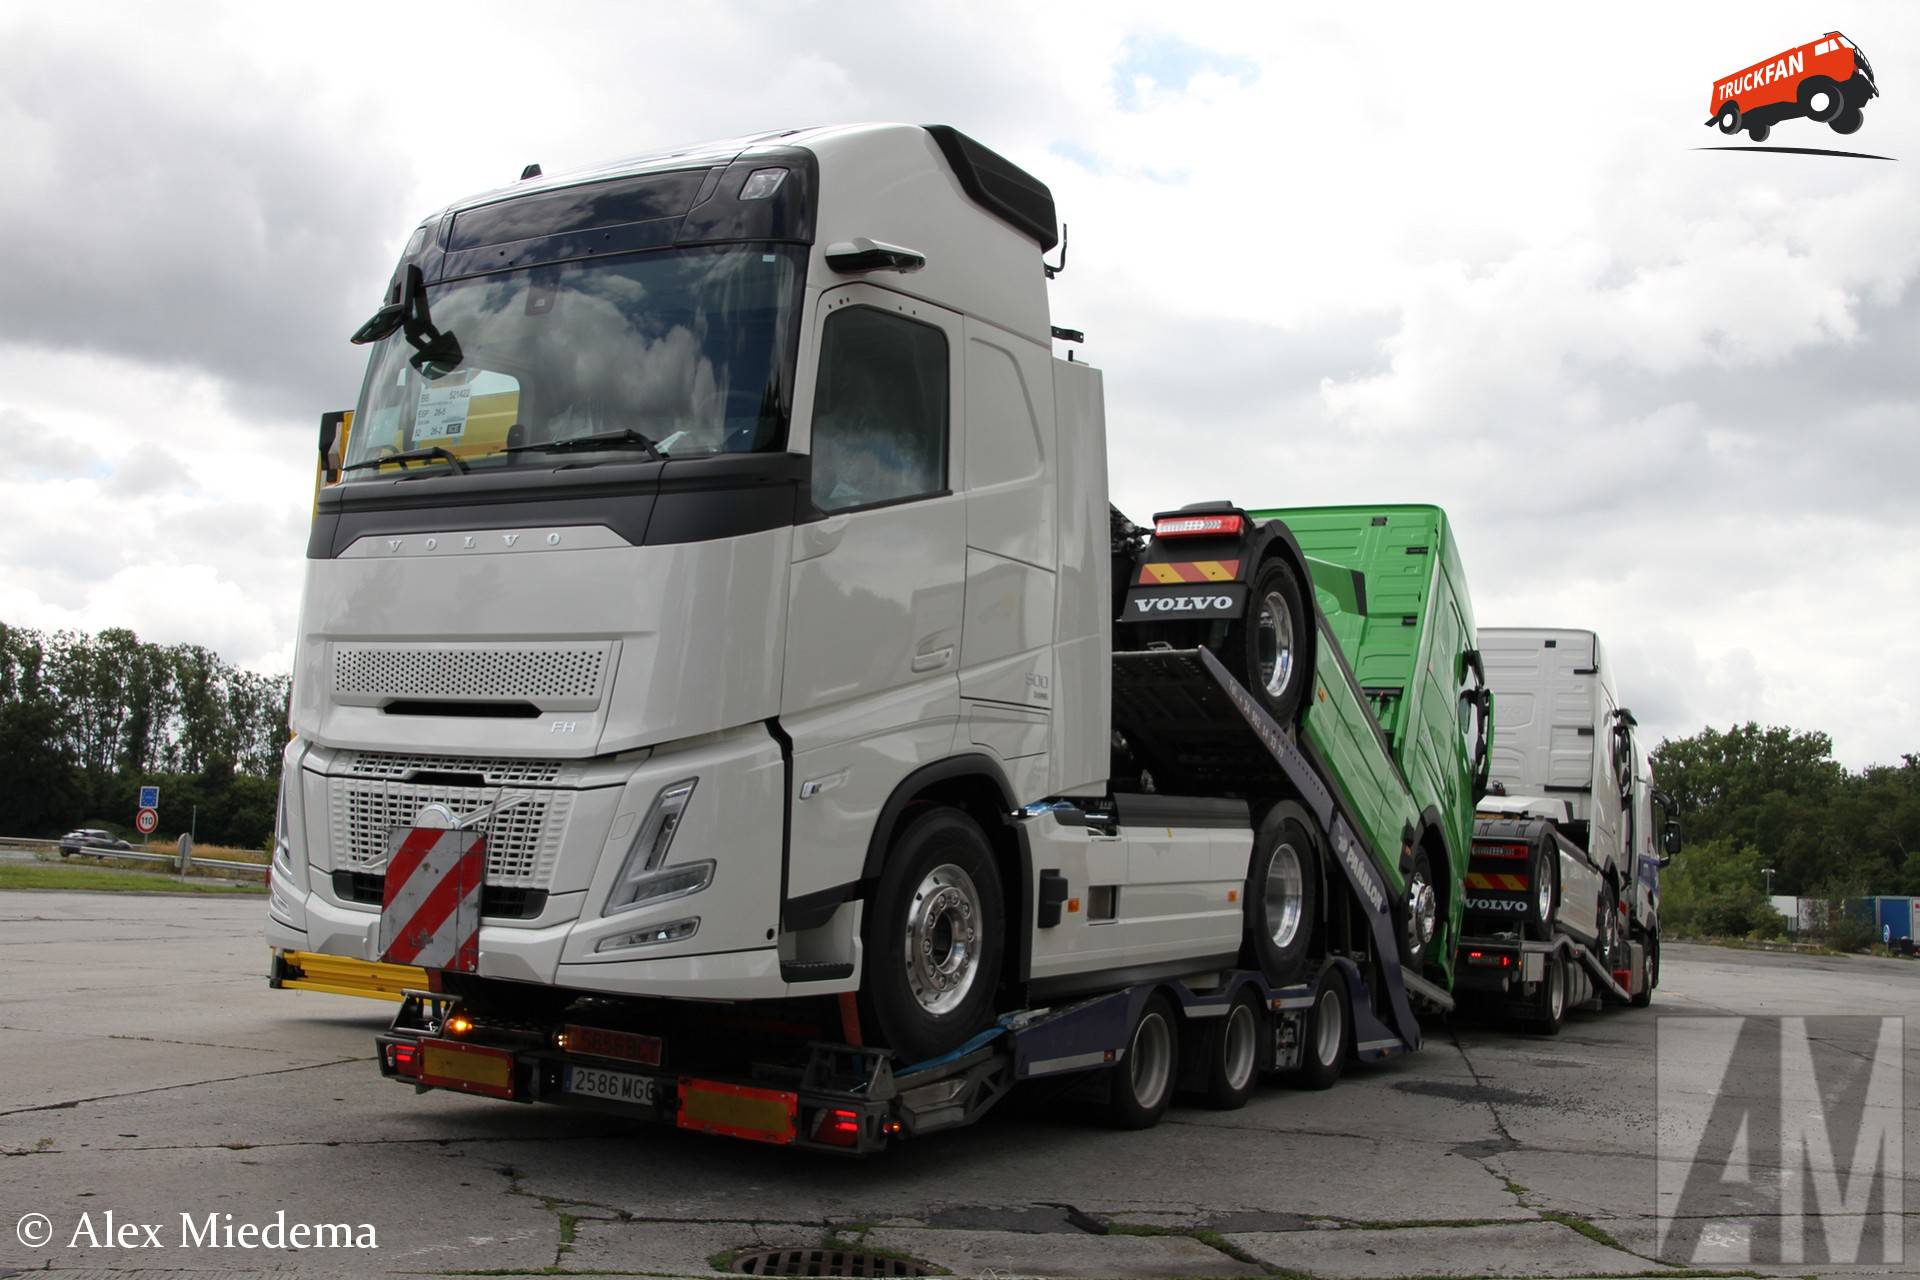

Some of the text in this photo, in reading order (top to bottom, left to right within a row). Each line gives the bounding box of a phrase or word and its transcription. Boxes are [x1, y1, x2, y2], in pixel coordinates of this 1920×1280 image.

[388, 532, 562, 552] VOLVO
[1134, 595, 1233, 612] VOLVO
[551, 720, 576, 733] FH
[141, 816, 154, 826] 110
[1464, 898, 1528, 912] VOLVO
[575, 1070, 619, 1096] 2586
